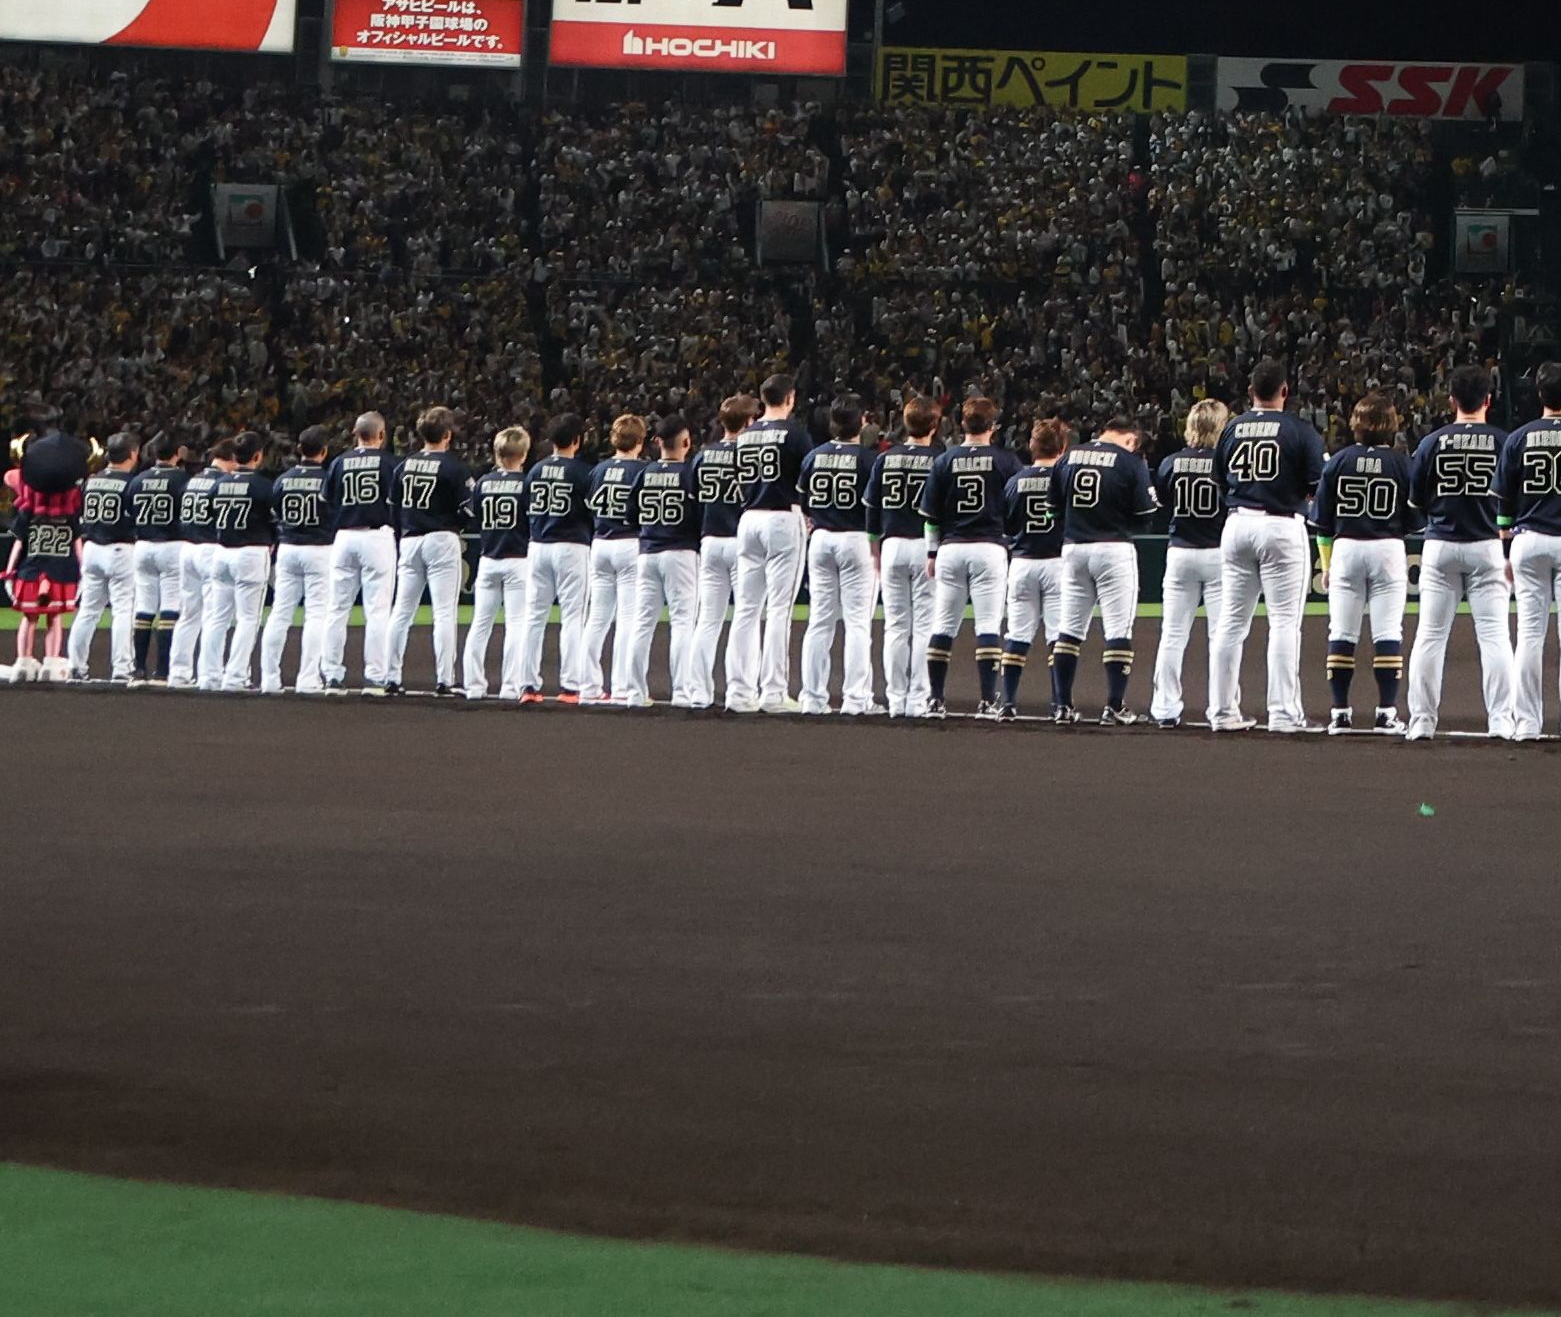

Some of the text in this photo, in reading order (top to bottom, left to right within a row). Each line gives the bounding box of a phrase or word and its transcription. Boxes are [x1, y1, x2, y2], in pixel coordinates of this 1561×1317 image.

[356, 29, 503, 50] オフィシャルビールです。
[370, 13, 488, 32] 阪神甲子園球場の
[645, 37, 776, 60] HOCHIKI
[882, 53, 1182, 110] 関西ペイント
[1326, 65, 1515, 117] SSK
[737, 446, 781, 483] 58
[1229, 440, 1280, 482] 40
[1436, 454, 1498, 496] 55
[342, 470, 380, 505] 16
[402, 474, 437, 510] 17
[529, 481, 573, 517] 35
[590, 483, 632, 518] 45
[808, 471, 858, 509] 96
[882, 471, 927, 509] 37
[957, 475, 986, 513] 3
[1072, 468, 1101, 508] 9
[1174, 477, 1220, 518] 10
[1336, 475, 1398, 520] 50
[84, 493, 122, 525] 88
[133, 494, 174, 526] 79
[214, 498, 252, 530] 77
[283, 493, 320, 525] 81
[481, 496, 518, 530] 19
[638, 489, 685, 525] 56
[1026, 495, 1055, 533] 5
